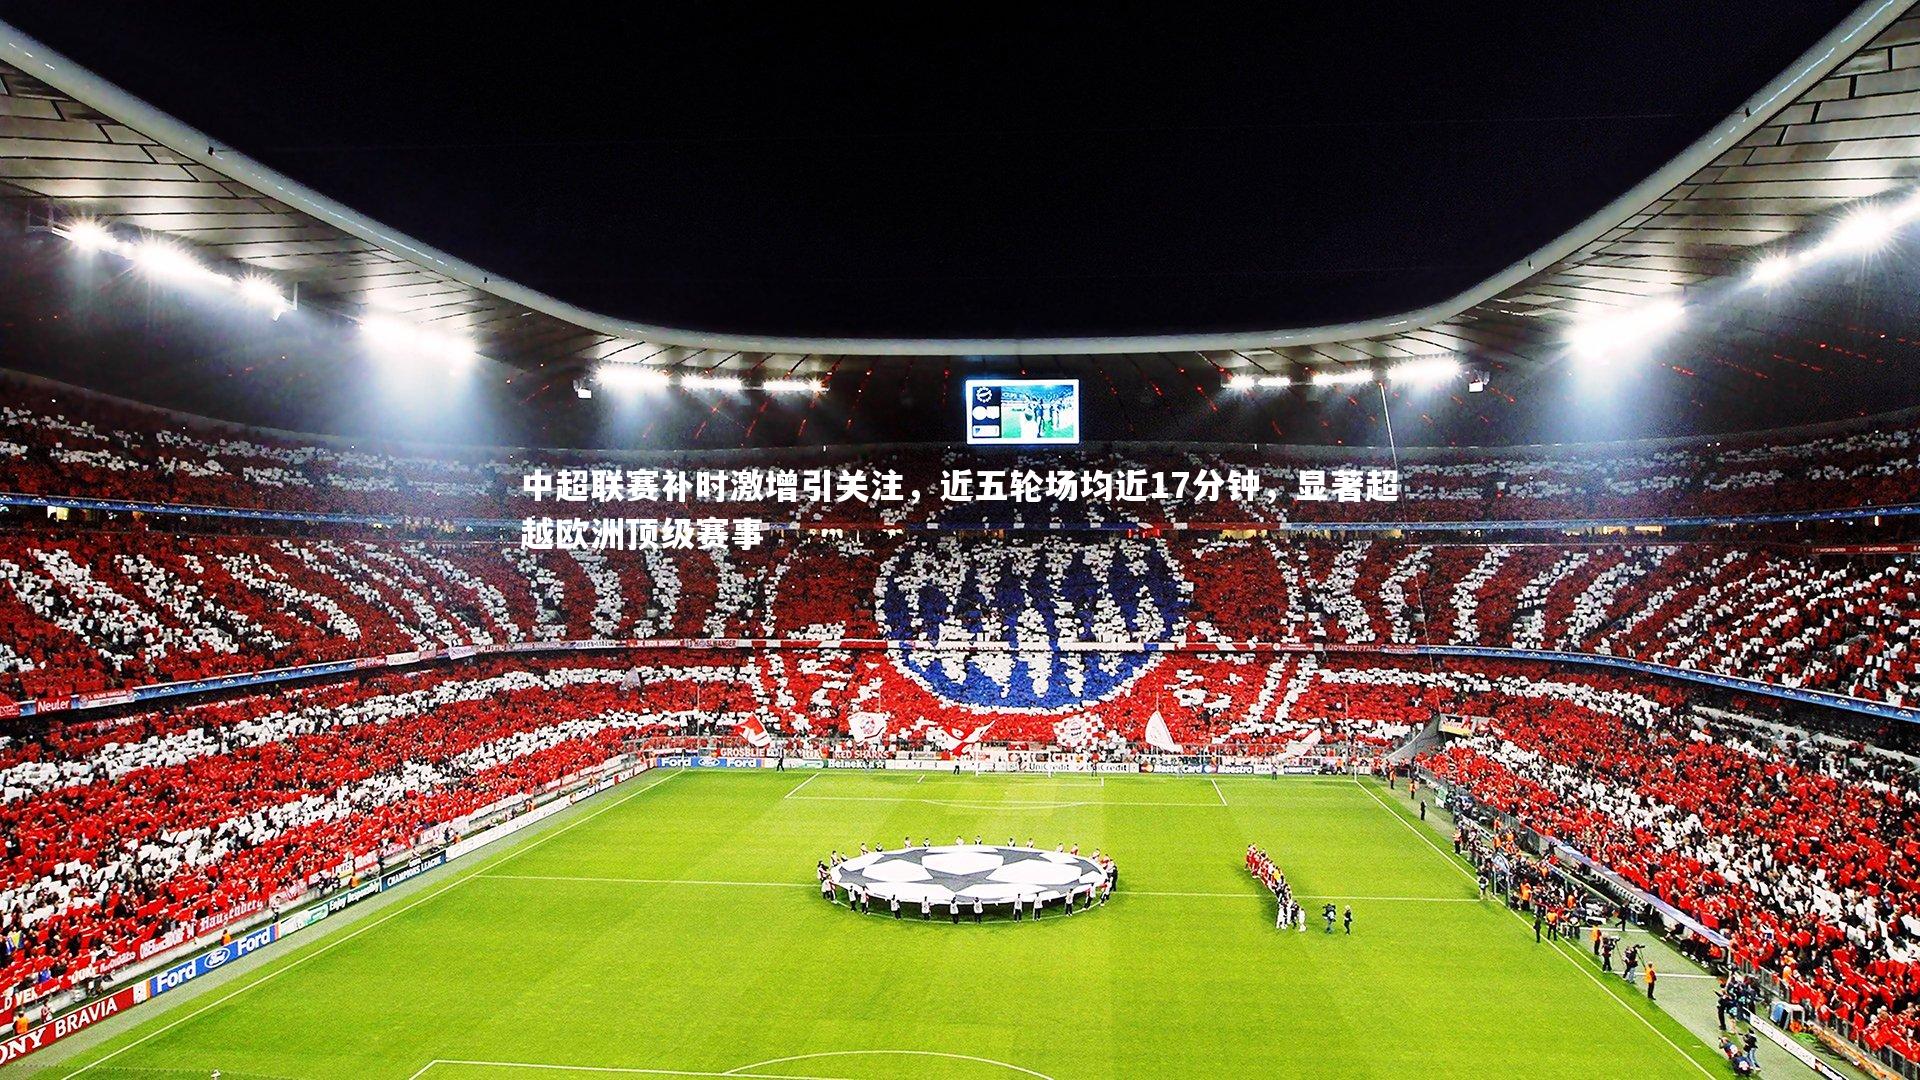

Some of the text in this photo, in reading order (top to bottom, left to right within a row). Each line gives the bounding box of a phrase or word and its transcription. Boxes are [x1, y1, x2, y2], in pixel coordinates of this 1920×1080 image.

[37, 699, 70, 712] Neuler
[661, 757, 691, 767] Ford
[726, 758, 757, 768] Ford
[1086, 764, 1127, 772] UiCredit
[329, 896, 347, 911] Enjoy
[237, 926, 271, 956] Ford
[156, 959, 197, 993] Ford
[0, 1027, 46, 1065] ONY
[55, 997, 118, 1038] BRAVIA
